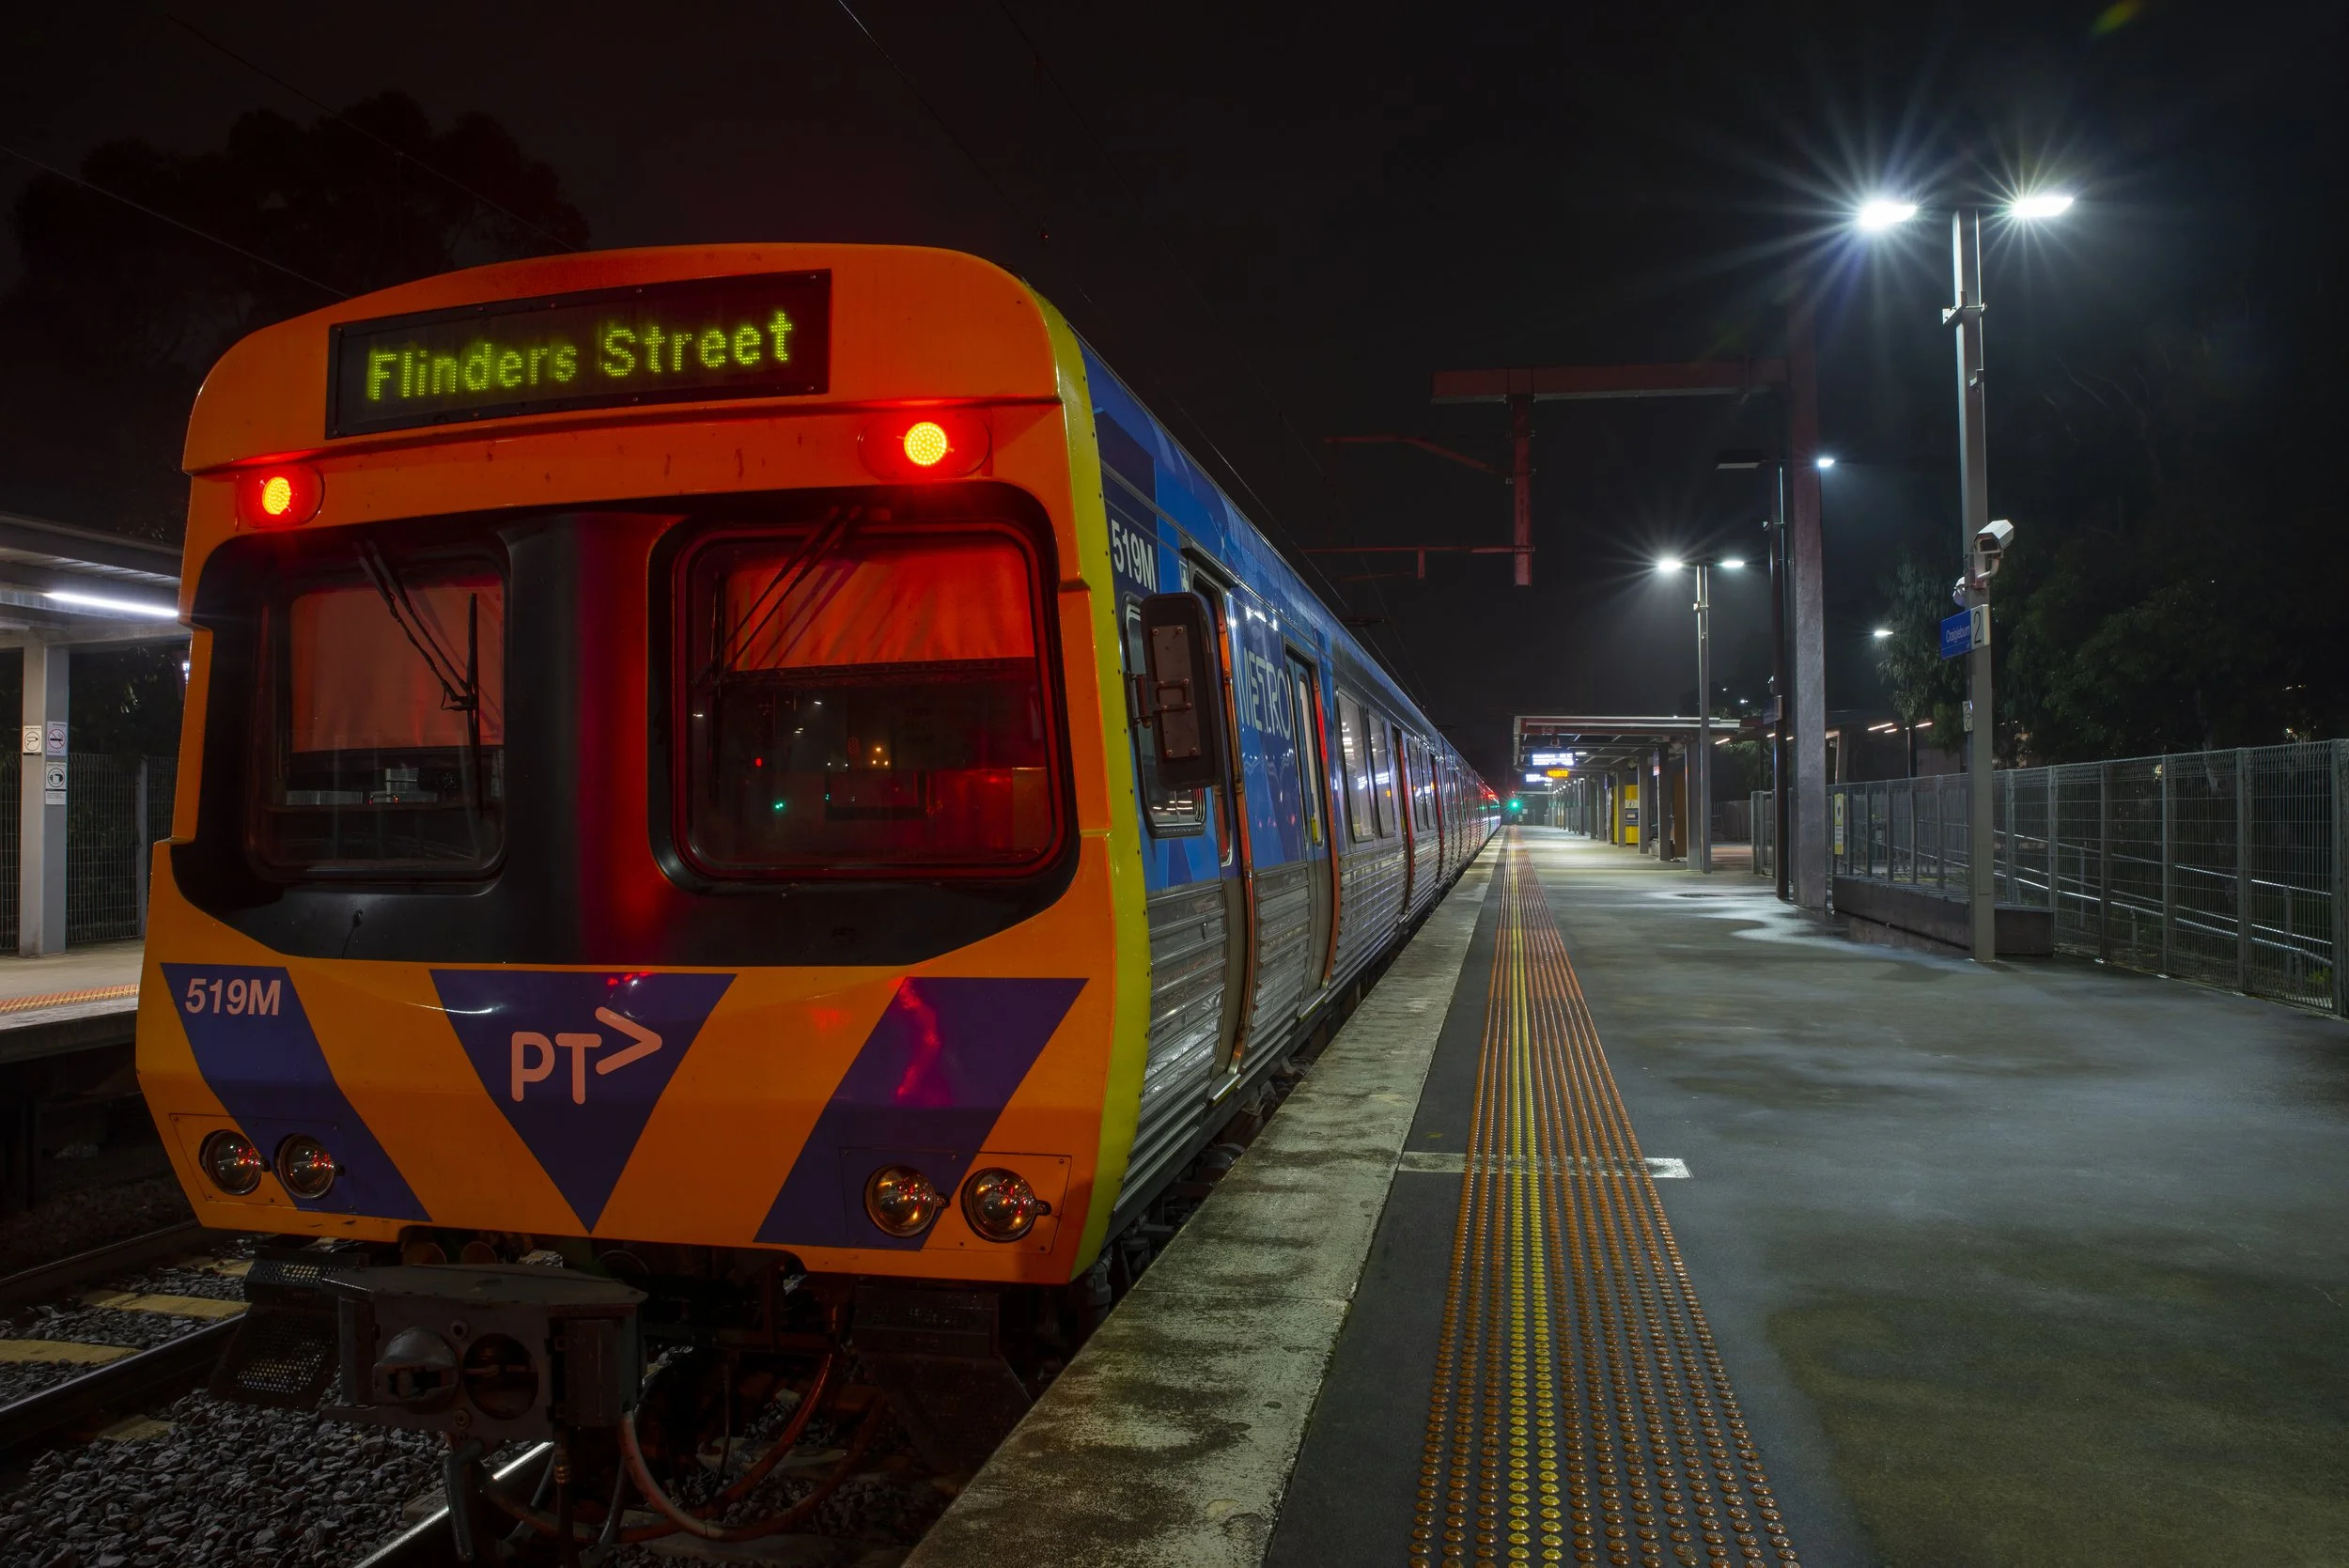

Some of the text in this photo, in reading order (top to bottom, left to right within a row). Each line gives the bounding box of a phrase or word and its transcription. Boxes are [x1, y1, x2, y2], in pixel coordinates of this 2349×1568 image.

[368, 310, 793, 401] Flinders Street
[1111, 518, 1157, 593] 519M
[1973, 611, 1982, 644] 2
[1234, 645, 1291, 740] METRO
[185, 978, 282, 1017] 519M
